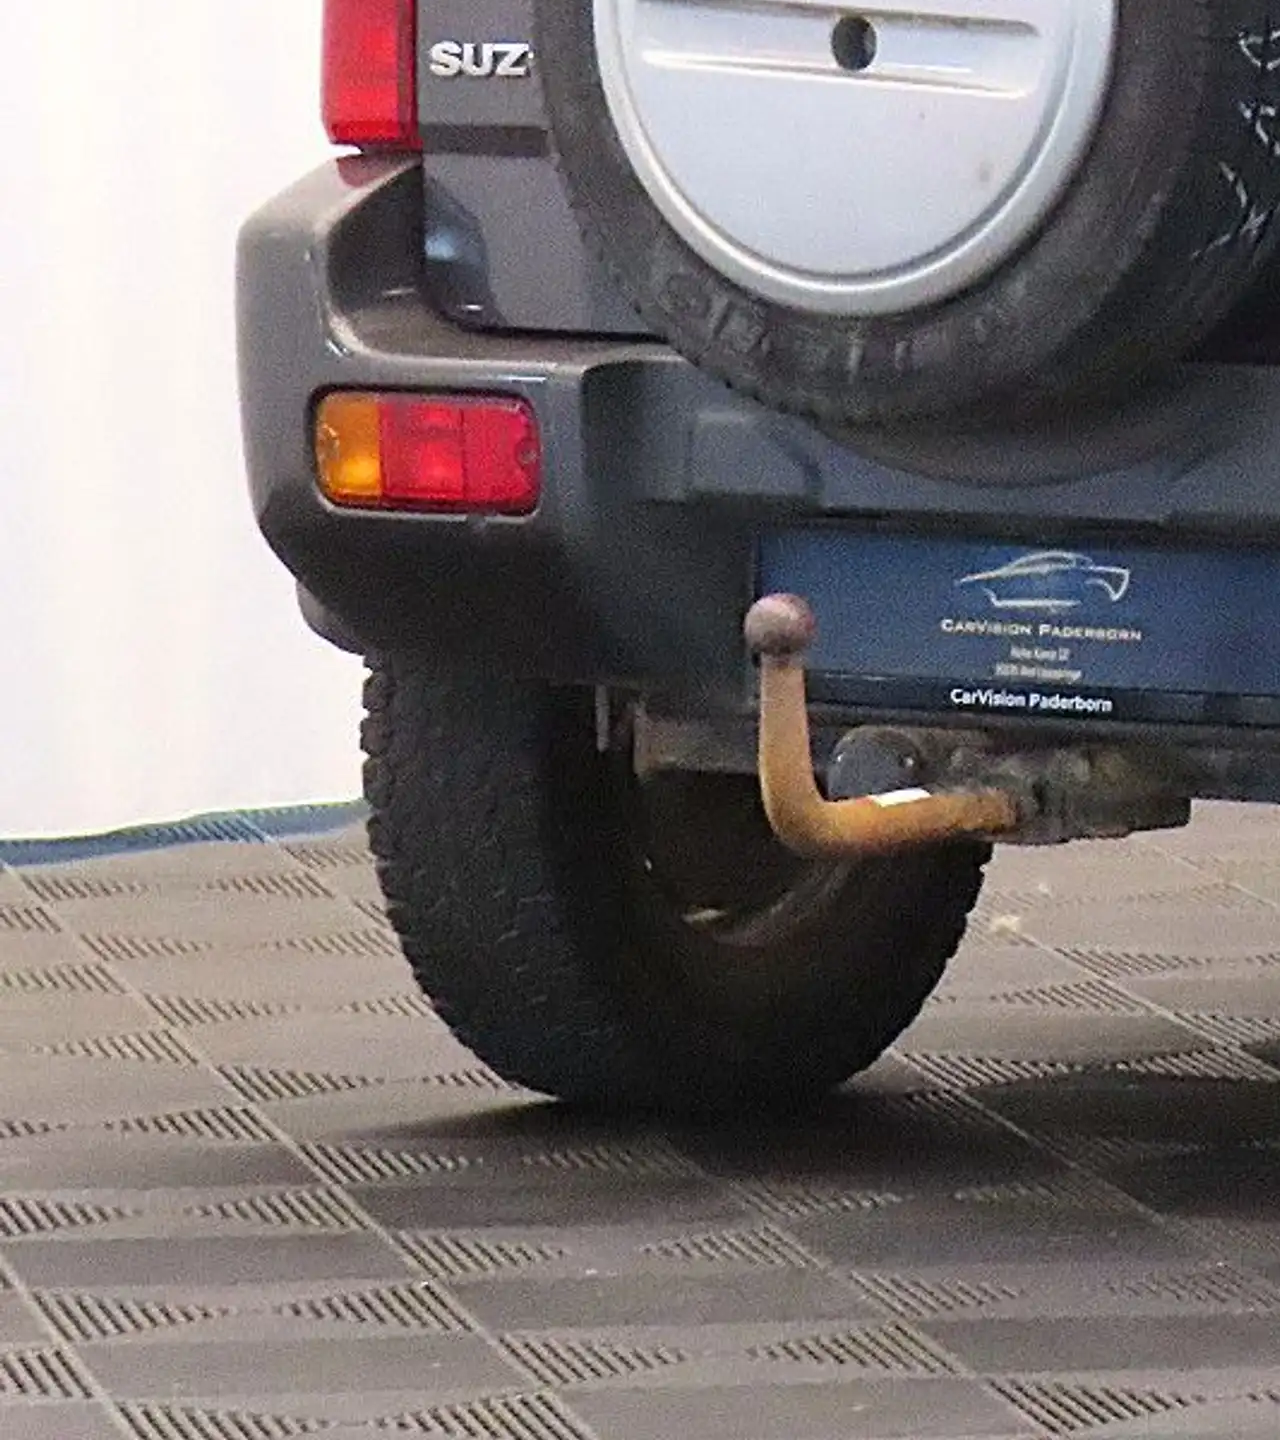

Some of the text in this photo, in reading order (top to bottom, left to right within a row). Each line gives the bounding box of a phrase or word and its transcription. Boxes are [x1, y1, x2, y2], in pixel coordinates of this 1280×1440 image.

[429, 40, 536, 76] SUZ
[950, 687, 1114, 712] CarVision Paderborn
